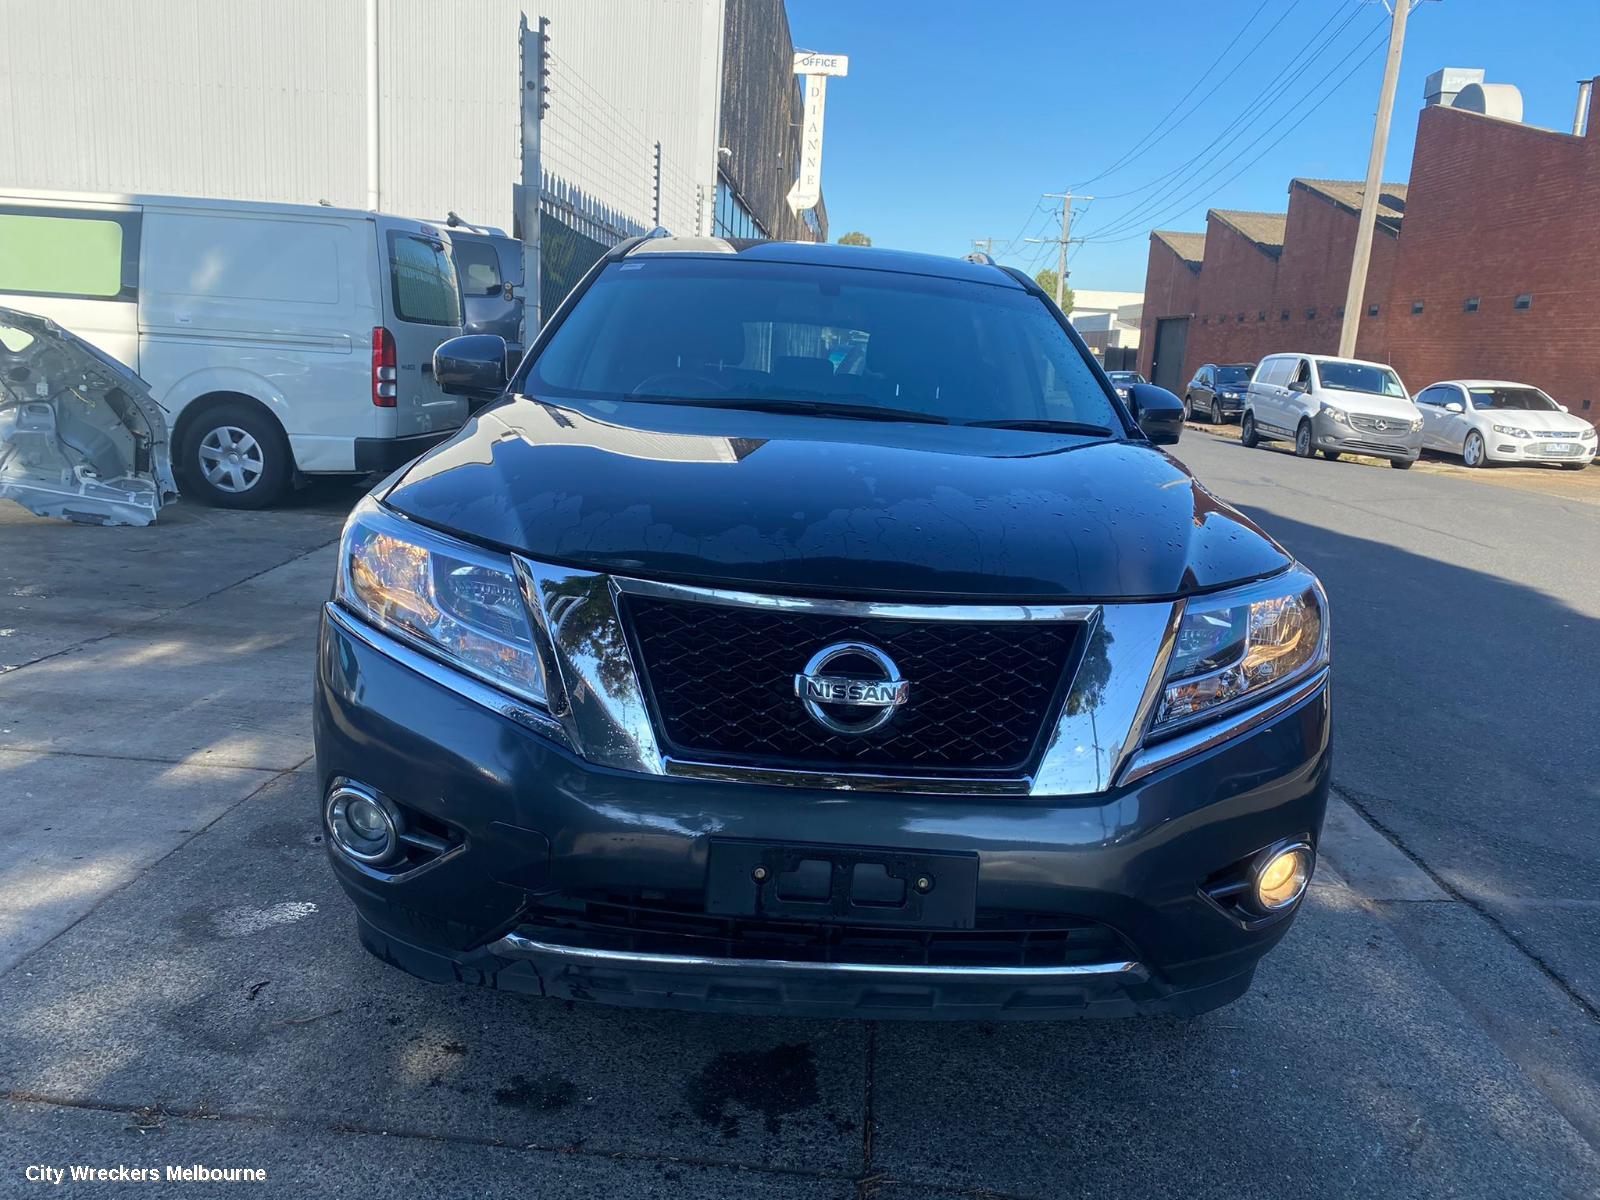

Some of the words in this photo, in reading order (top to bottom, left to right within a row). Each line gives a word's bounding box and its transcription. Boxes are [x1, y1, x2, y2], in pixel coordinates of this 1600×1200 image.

[802, 57, 837, 68] OFFICE
[806, 87, 820, 185] DIANNE
[806, 681, 897, 701] NISSAN
